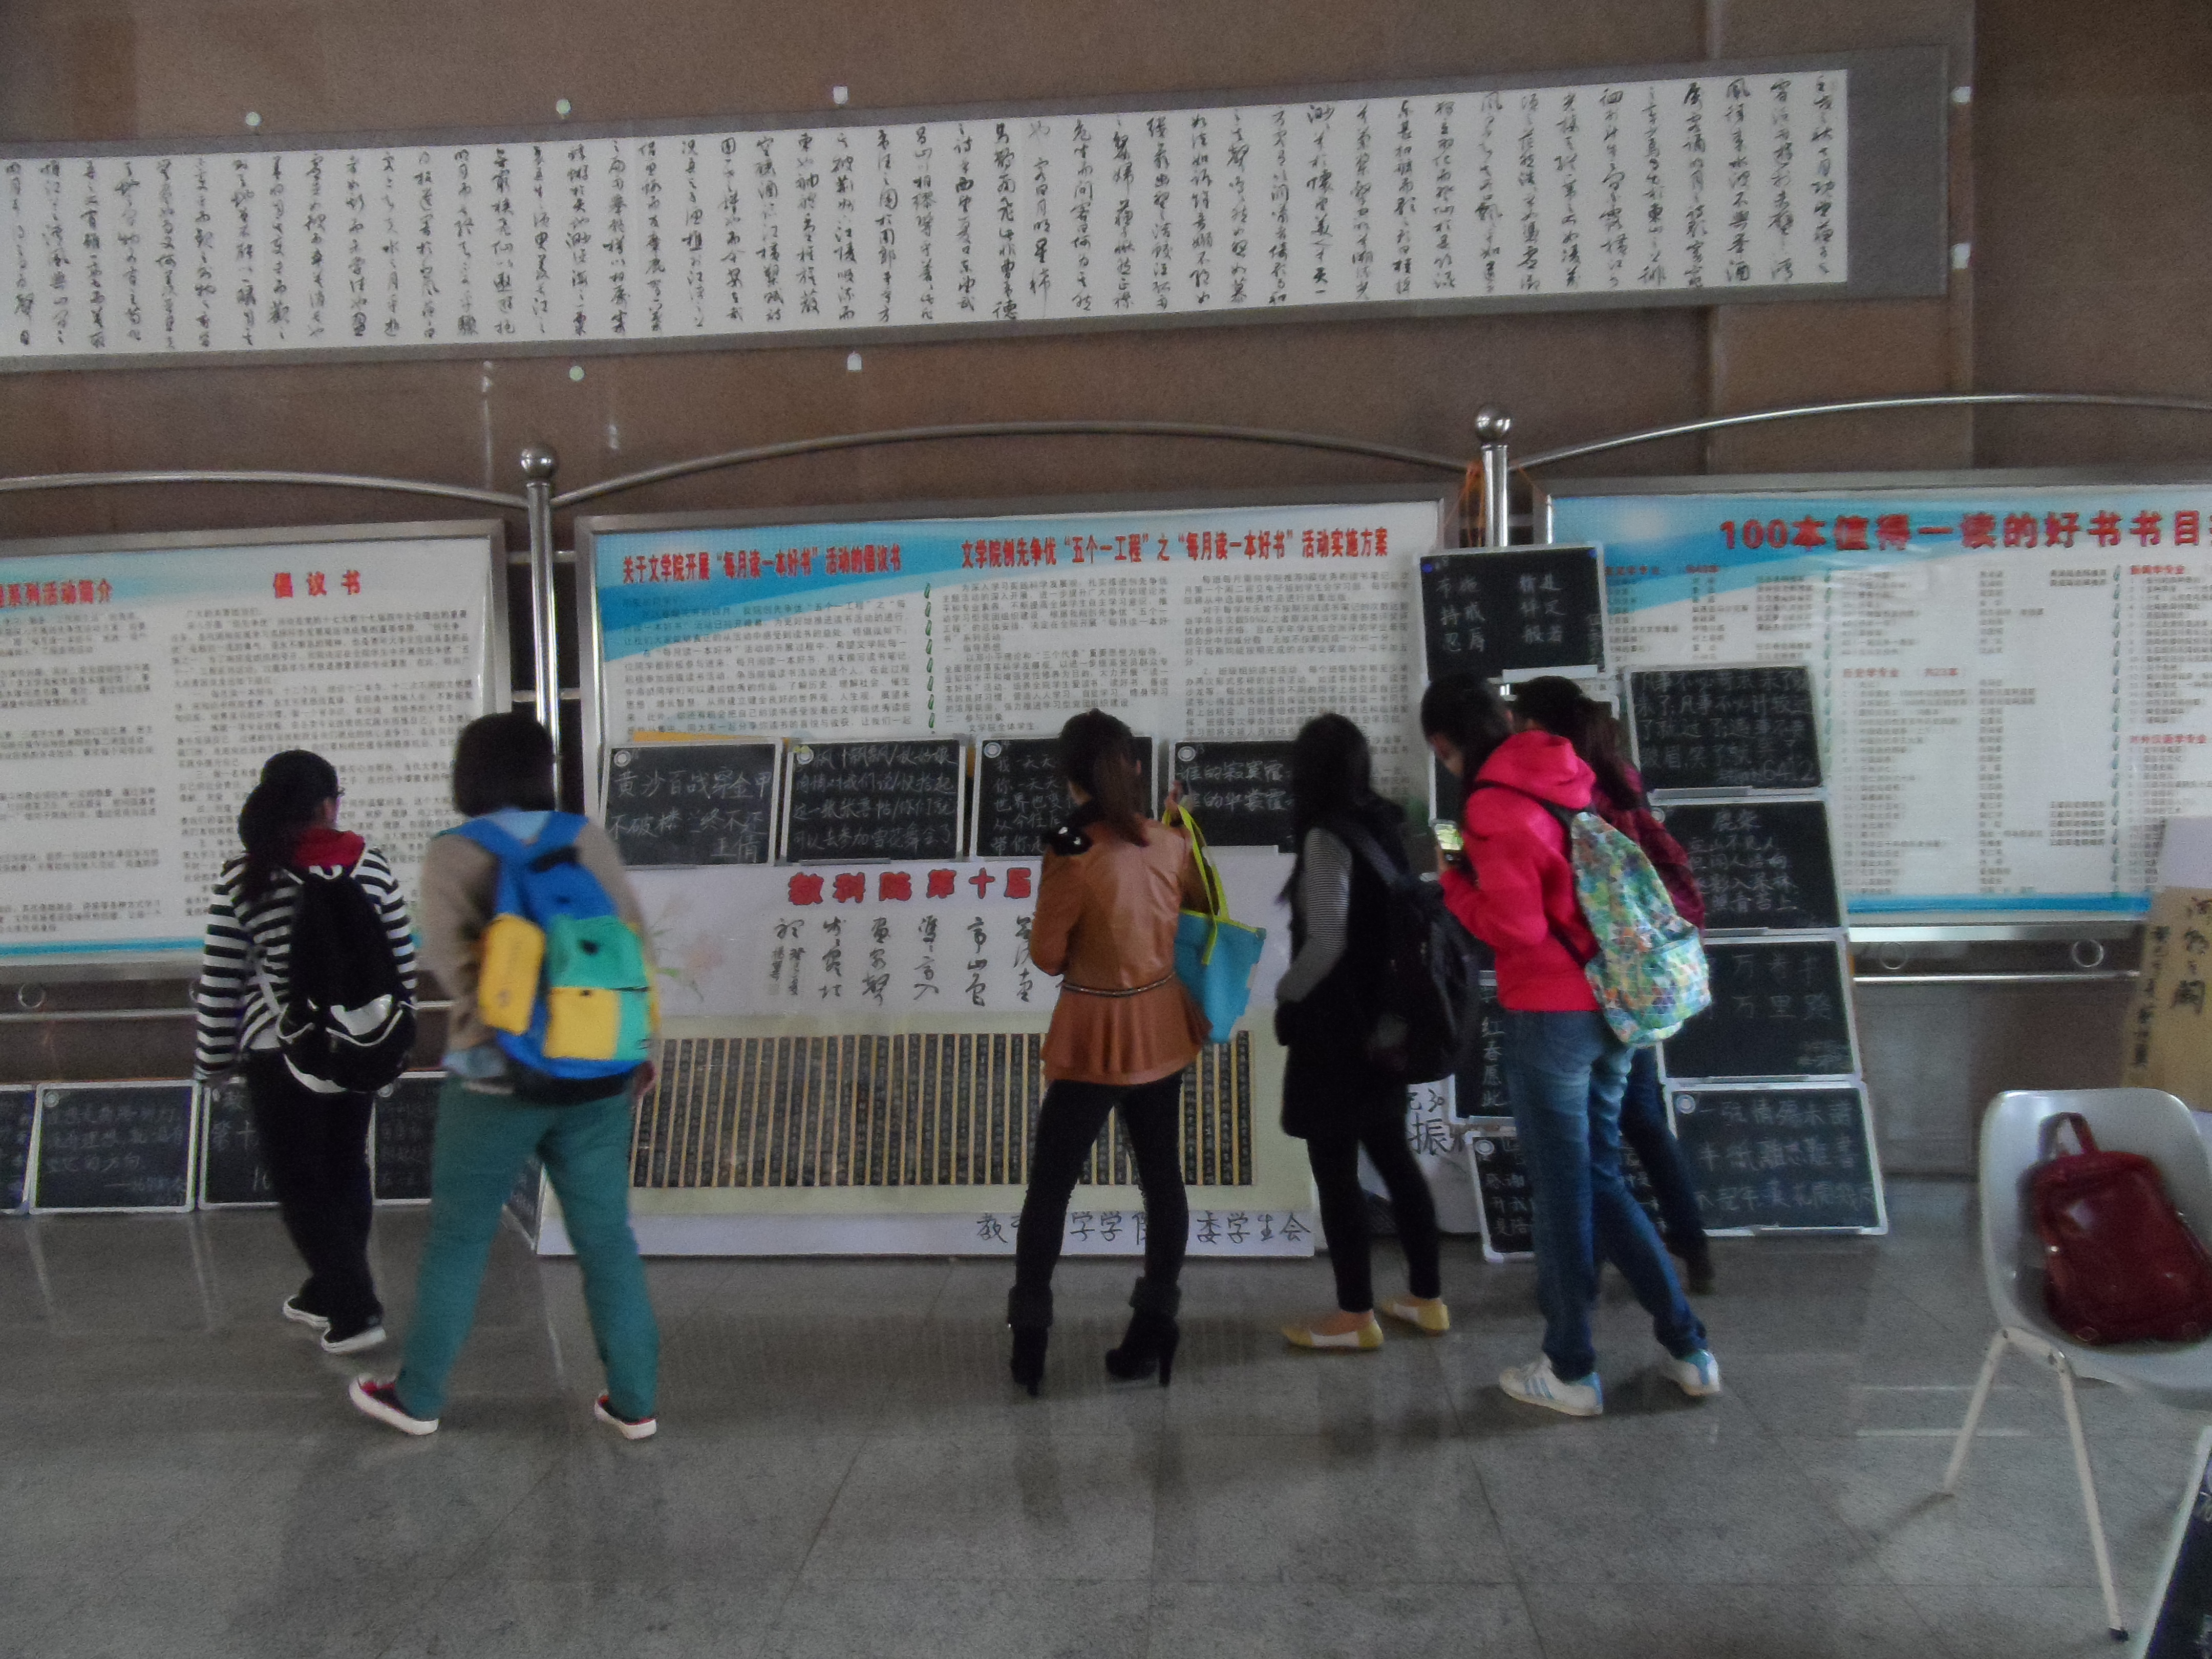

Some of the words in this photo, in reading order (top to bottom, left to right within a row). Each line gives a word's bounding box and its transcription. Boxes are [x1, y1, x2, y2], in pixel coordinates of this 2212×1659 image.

[1721, 511, 2212, 551] 100本值得一读的好书书目
[0, 578, 113, 608] 系列活动简介
[273, 569, 361, 599] 倡议书
